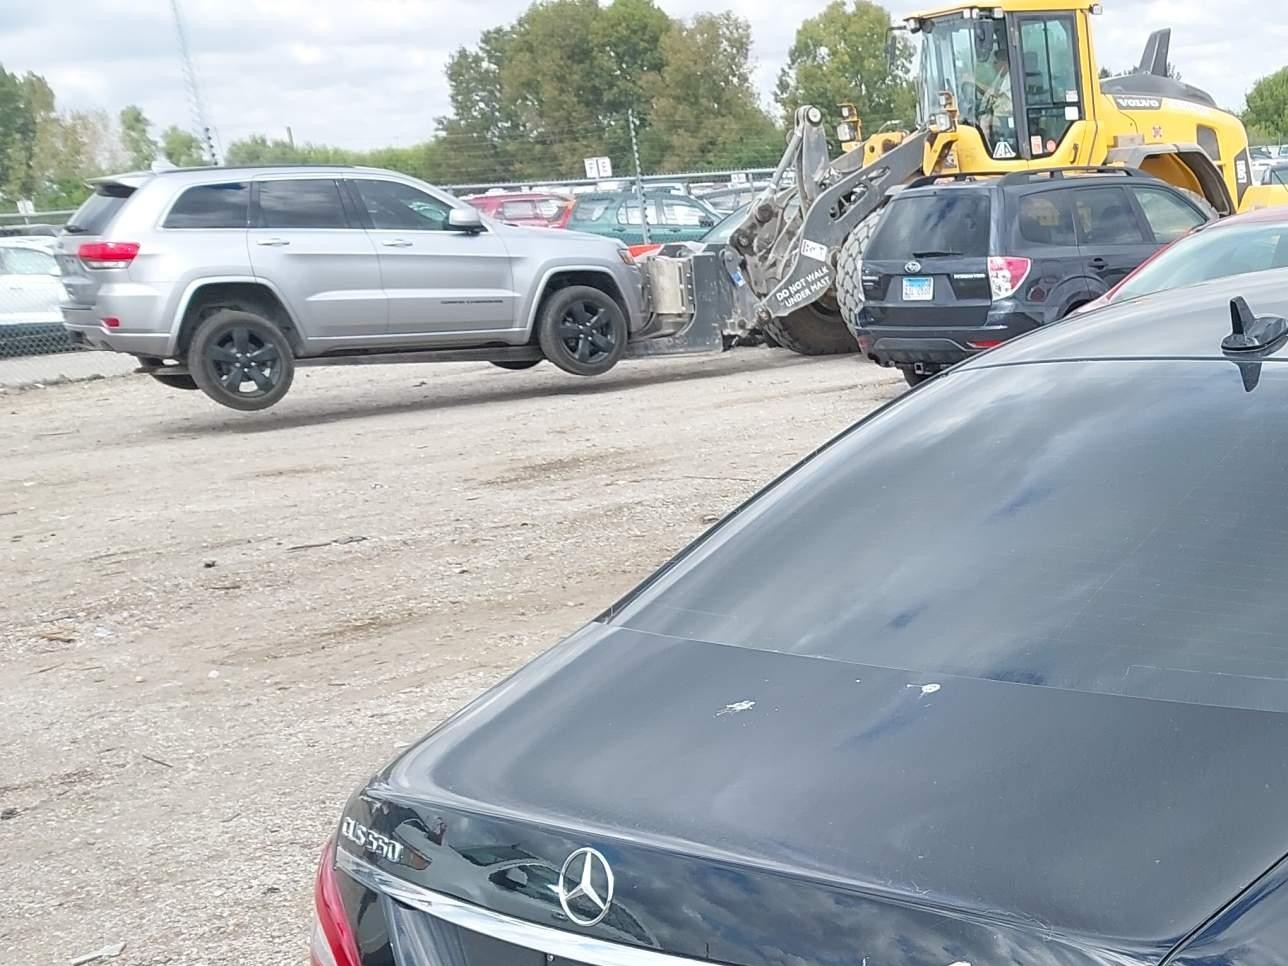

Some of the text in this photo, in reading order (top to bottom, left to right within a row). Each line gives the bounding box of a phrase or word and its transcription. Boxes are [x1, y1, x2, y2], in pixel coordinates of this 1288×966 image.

[1117, 98, 1160, 108] VOLVO
[776, 265, 829, 301] DO NOT WALK
[784, 276, 831, 307] UNDER MAST
